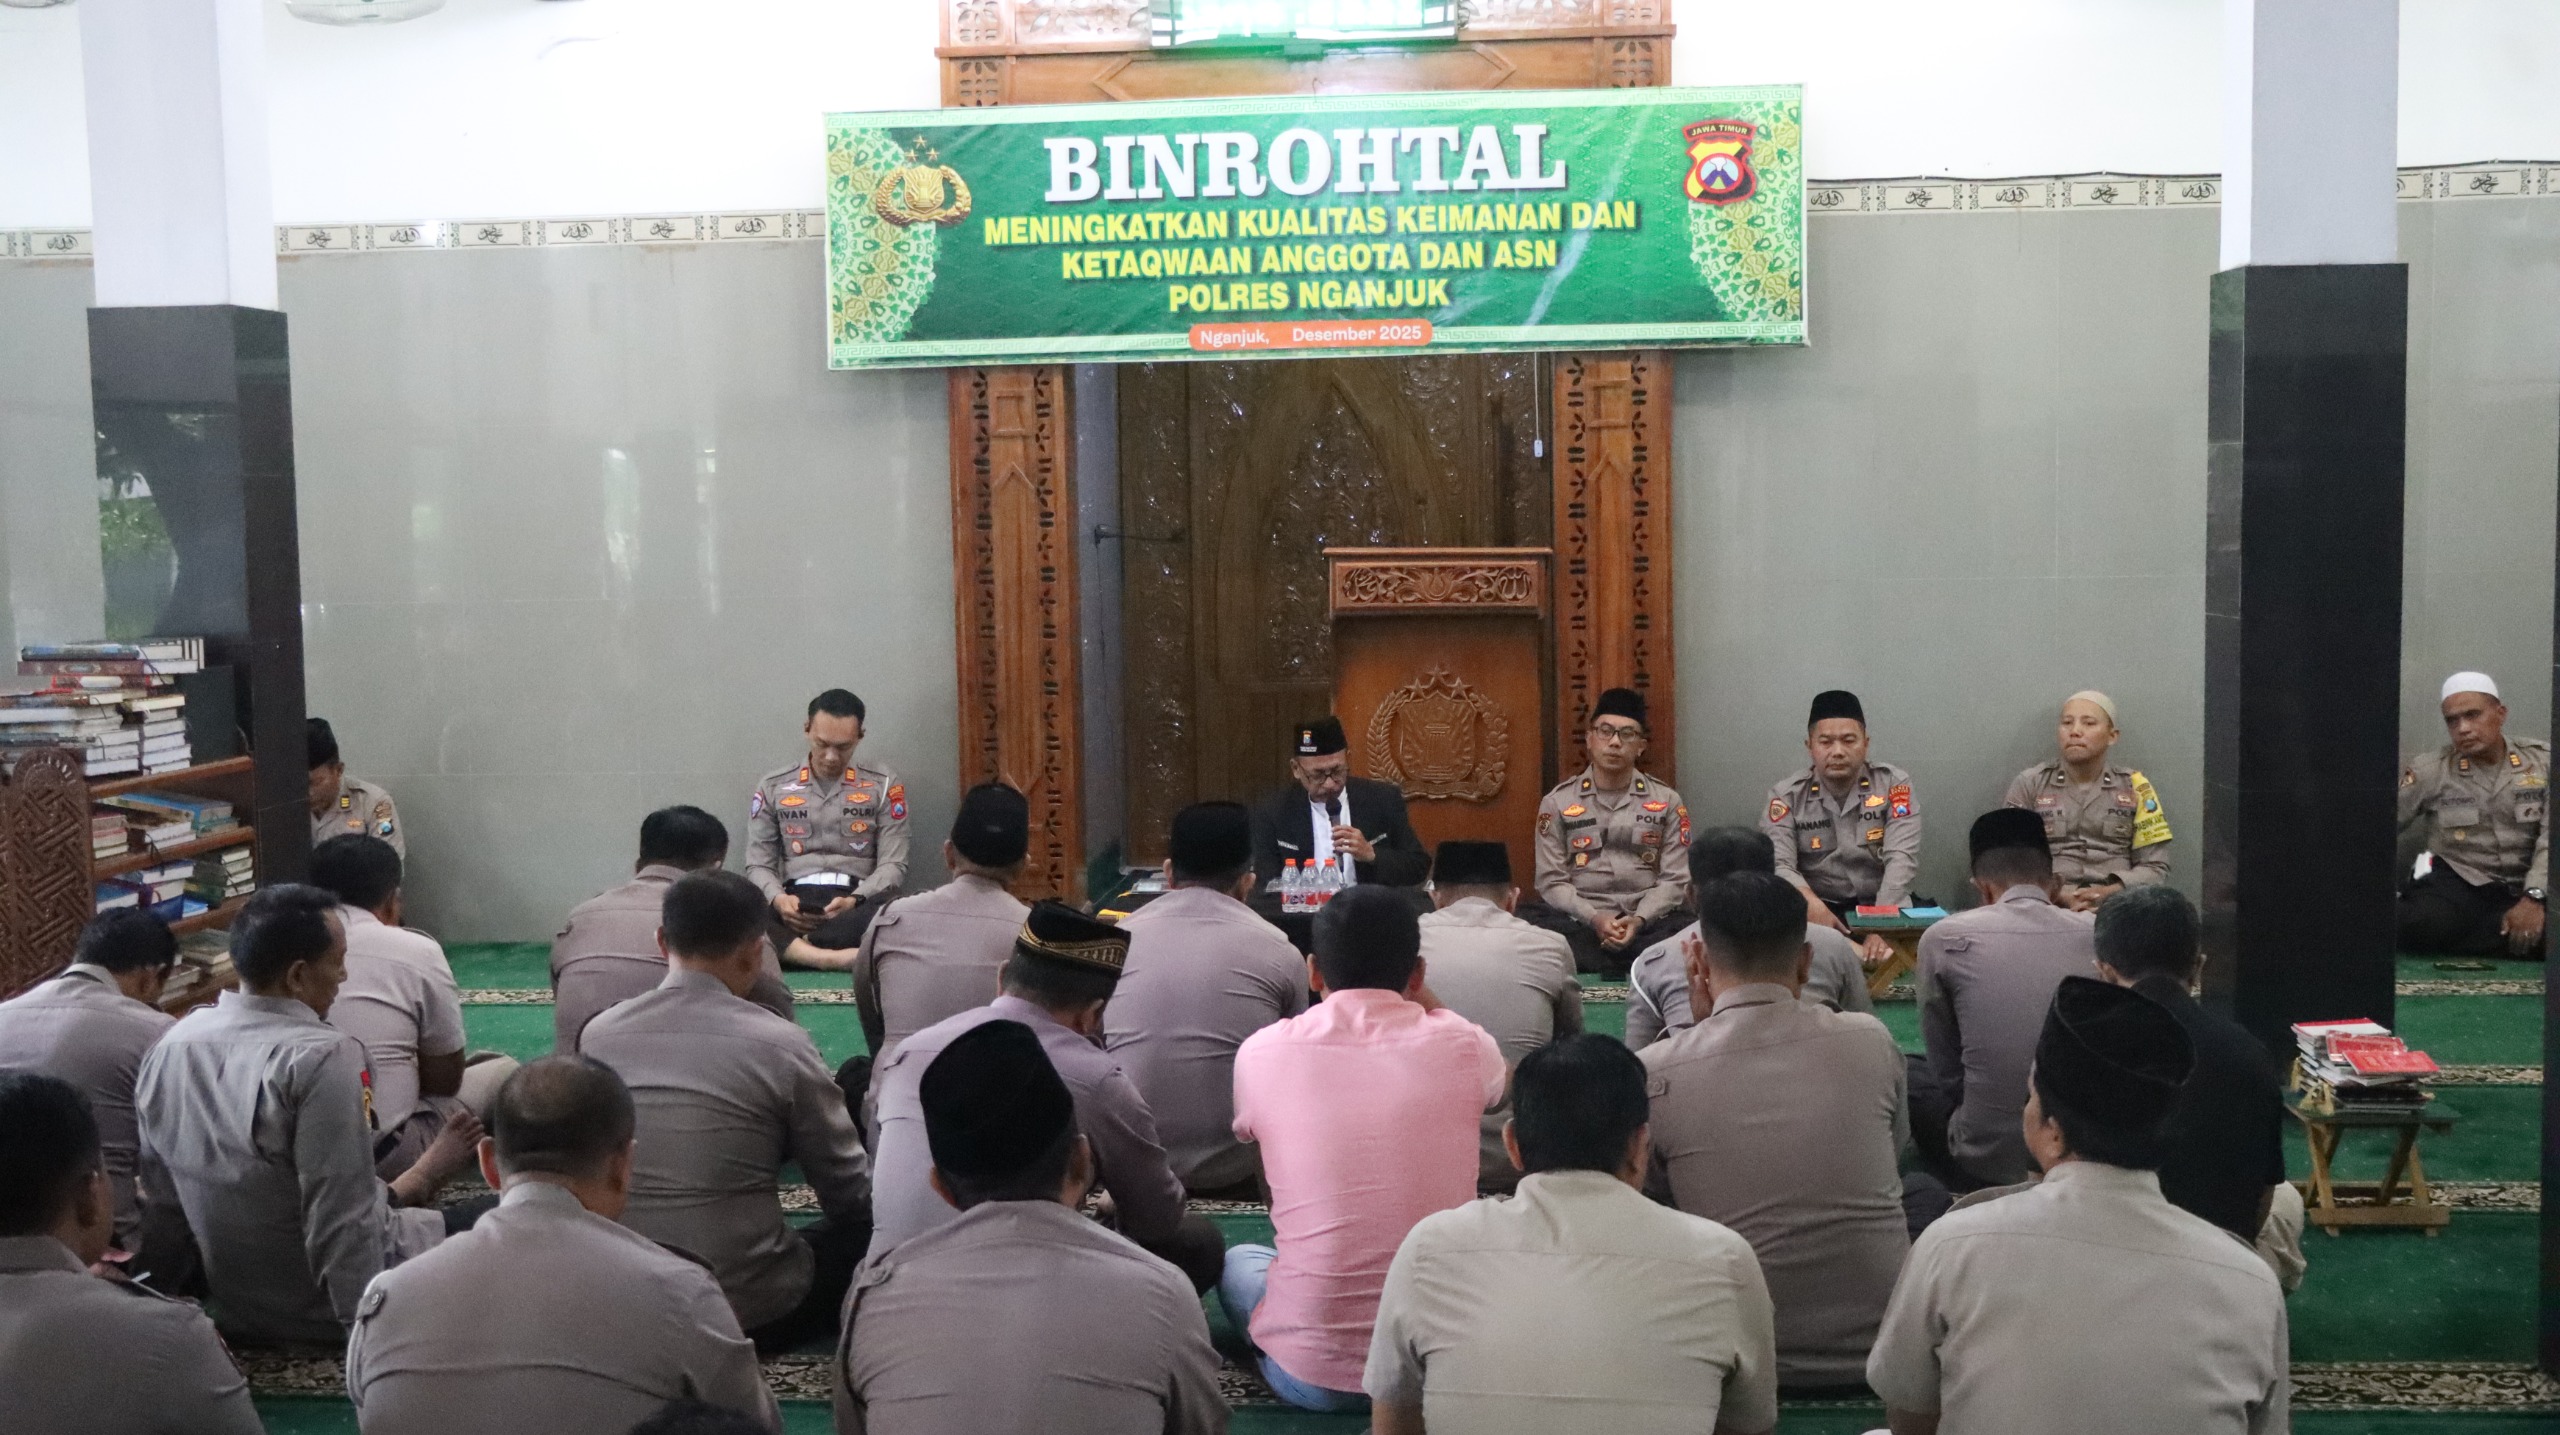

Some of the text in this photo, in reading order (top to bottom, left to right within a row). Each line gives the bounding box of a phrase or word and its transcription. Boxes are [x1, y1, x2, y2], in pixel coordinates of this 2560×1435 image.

[1691, 124, 1748, 136] JAWA TIMUR
[1043, 123, 1567, 202] BINROHTAL
[984, 200, 1636, 245] MENINGKATKAN KUALITAS KEIMANAN DAN
[1062, 238, 1557, 280] KETAQWAAN ANGGOTA DAN ASN
[1169, 277, 1451, 313] POLRES NGANJUK
[1199, 324, 1422, 348] Nganjuk, Desember 2025
[779, 810, 808, 820] IVAN
[842, 807, 876, 817] POLRI
[1636, 814, 1668, 826] POLR
